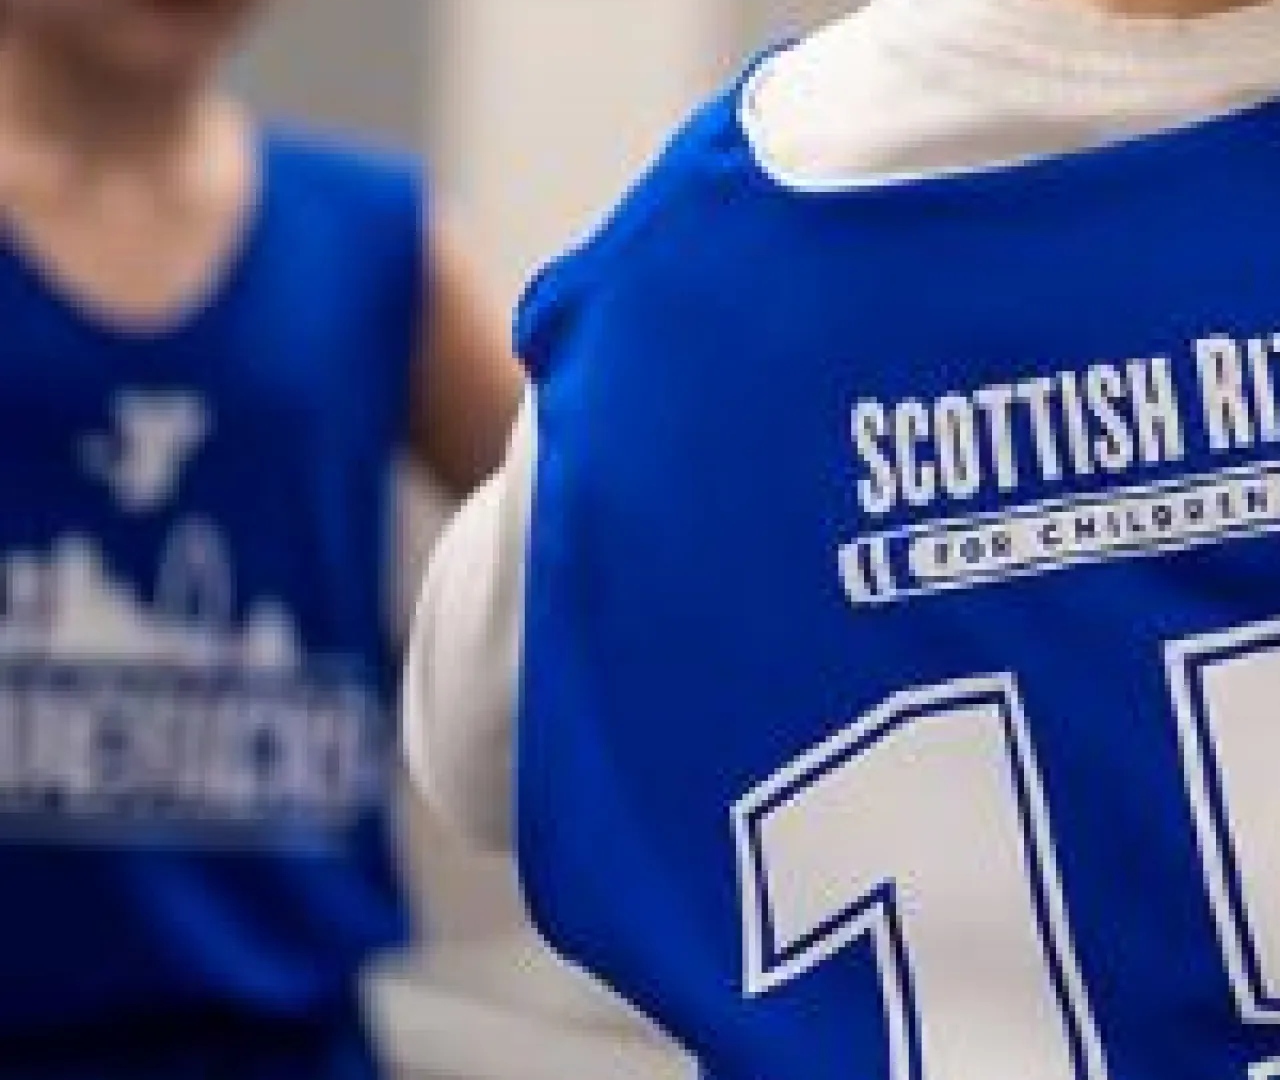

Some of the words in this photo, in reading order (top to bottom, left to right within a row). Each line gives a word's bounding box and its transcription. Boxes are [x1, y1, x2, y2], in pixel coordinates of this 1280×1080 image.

[850, 356, 1186, 515] SCOTTISH
[932, 532, 1014, 566] FOR
[1040, 485, 1270, 547] CHILDREN
